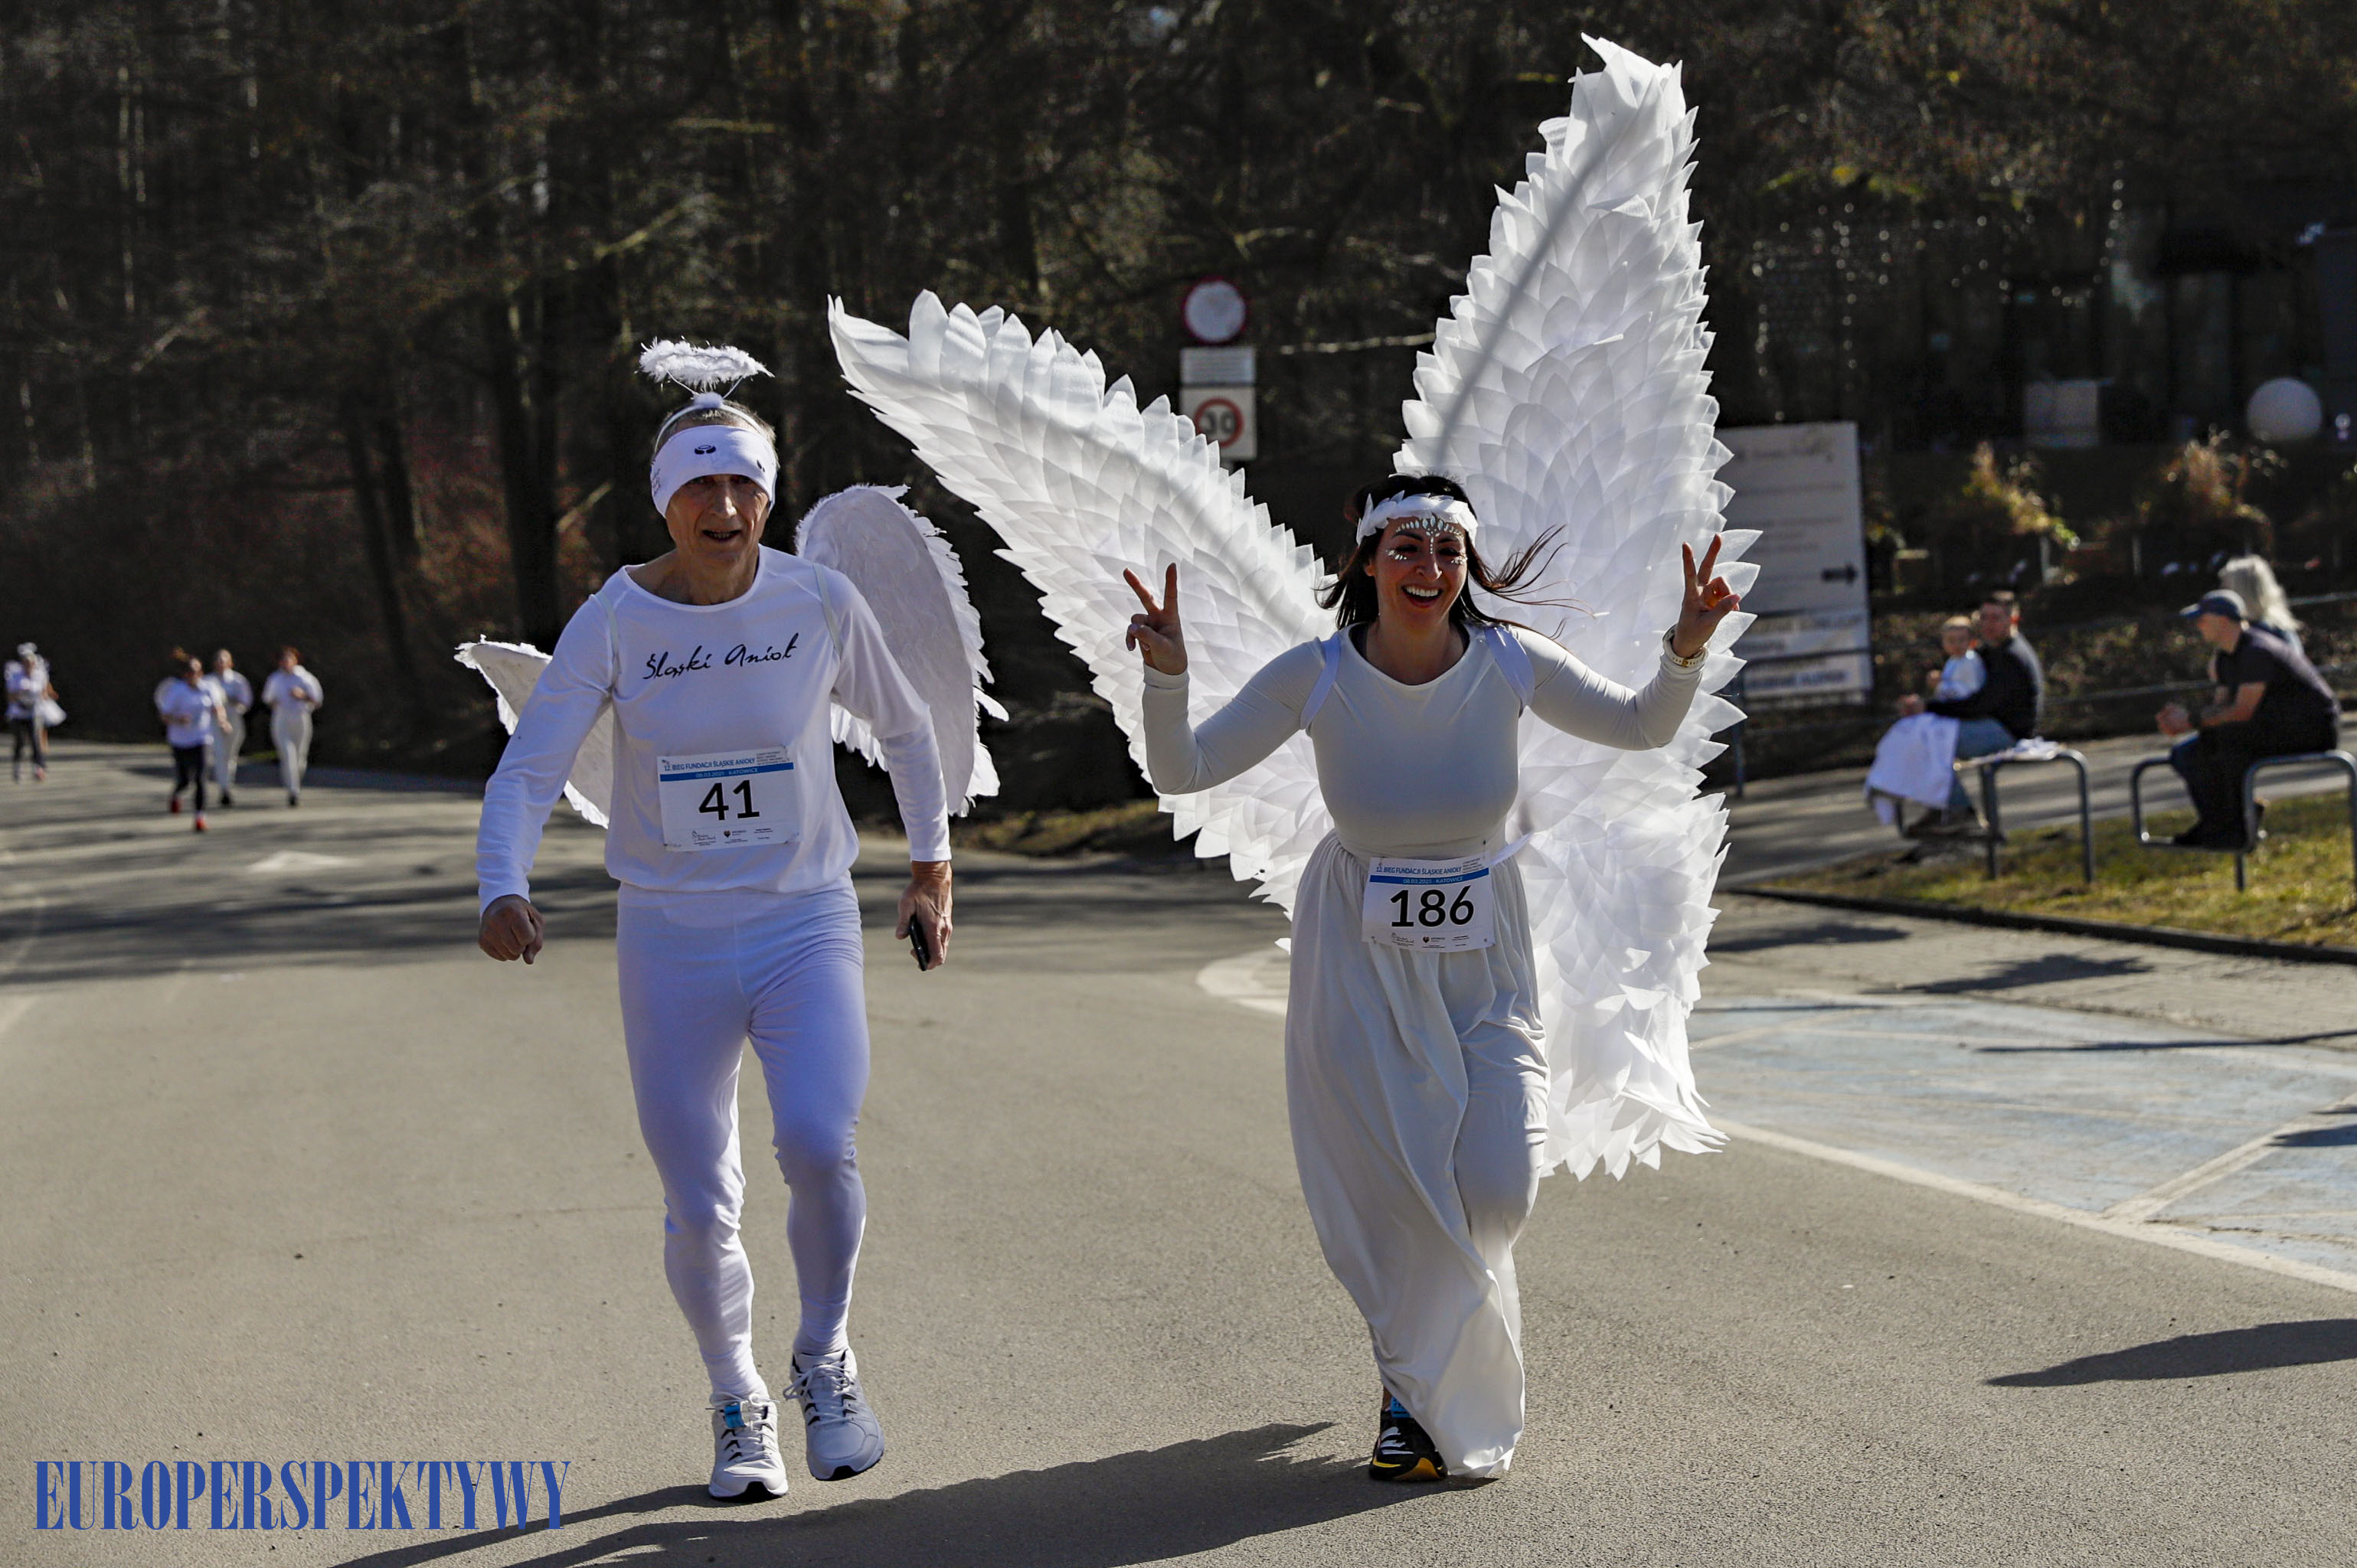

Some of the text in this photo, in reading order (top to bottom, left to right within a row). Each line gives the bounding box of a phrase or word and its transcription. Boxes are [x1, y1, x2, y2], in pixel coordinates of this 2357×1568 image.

[685, 761, 712, 770] FUNDACJI
[713, 759, 734, 768] ŚLĄSKIE
[735, 757, 756, 766] ANIOŁY
[698, 779, 760, 821] 41
[1421, 867, 1443, 876] ŚLĄSKIE
[1390, 884, 1475, 927] 186
